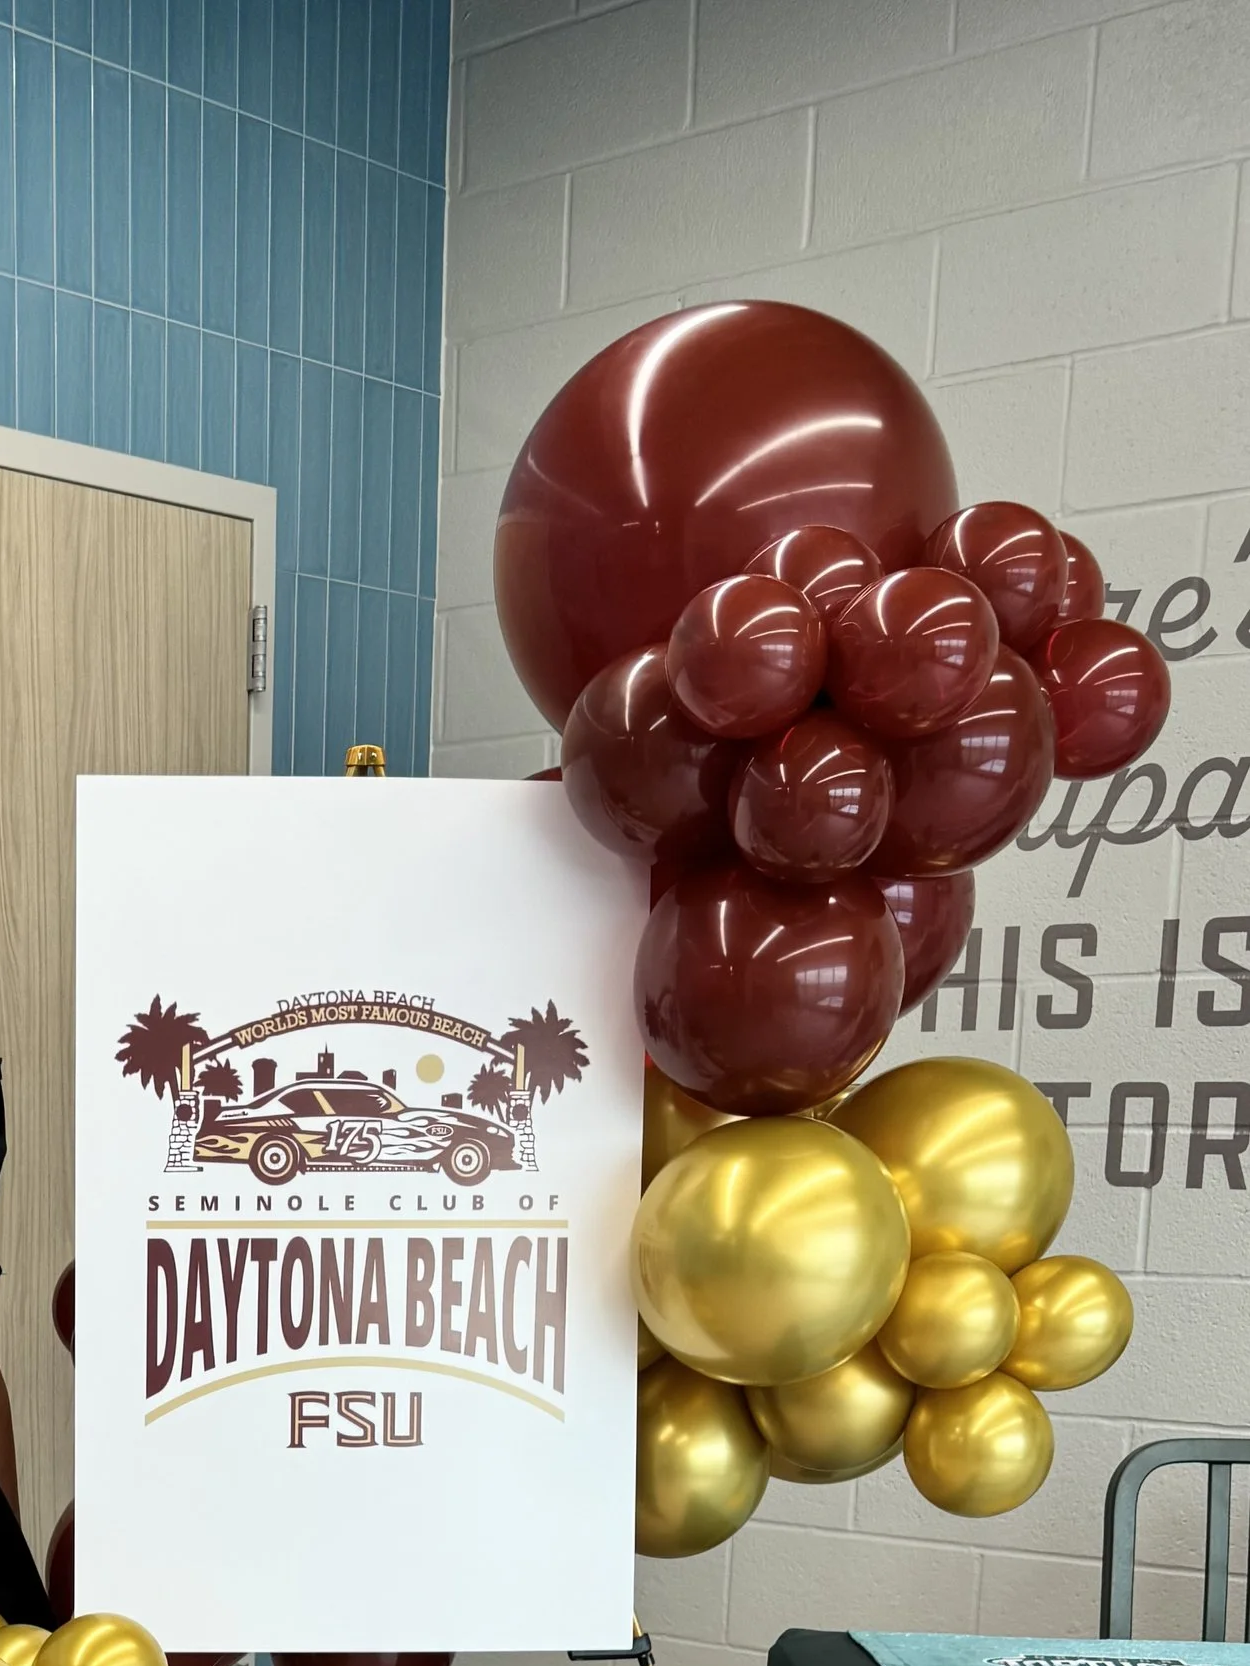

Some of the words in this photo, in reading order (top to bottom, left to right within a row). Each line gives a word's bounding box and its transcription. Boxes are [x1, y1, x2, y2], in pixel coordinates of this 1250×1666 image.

[1155, 916, 1250, 1028] IS
[277, 990, 365, 1013] DAYTONA
[372, 990, 435, 1011] BEACH
[235, 1008, 308, 1047] WORLD'S
[311, 1005, 358, 1024] MOST
[361, 1006, 430, 1028] FAMOUS
[432, 1016, 487, 1048] BEACH
[325, 1119, 384, 1164] 175
[430, 1127, 449, 1136] FSU
[148, 1194, 356, 1212] SEMINOLE
[388, 1194, 486, 1212] CLUB
[518, 1194, 560, 1211] OF
[146, 1236, 390, 1400] DAYTONA
[404, 1236, 568, 1396] BEACH
[286, 1391, 423, 1449] FSU
